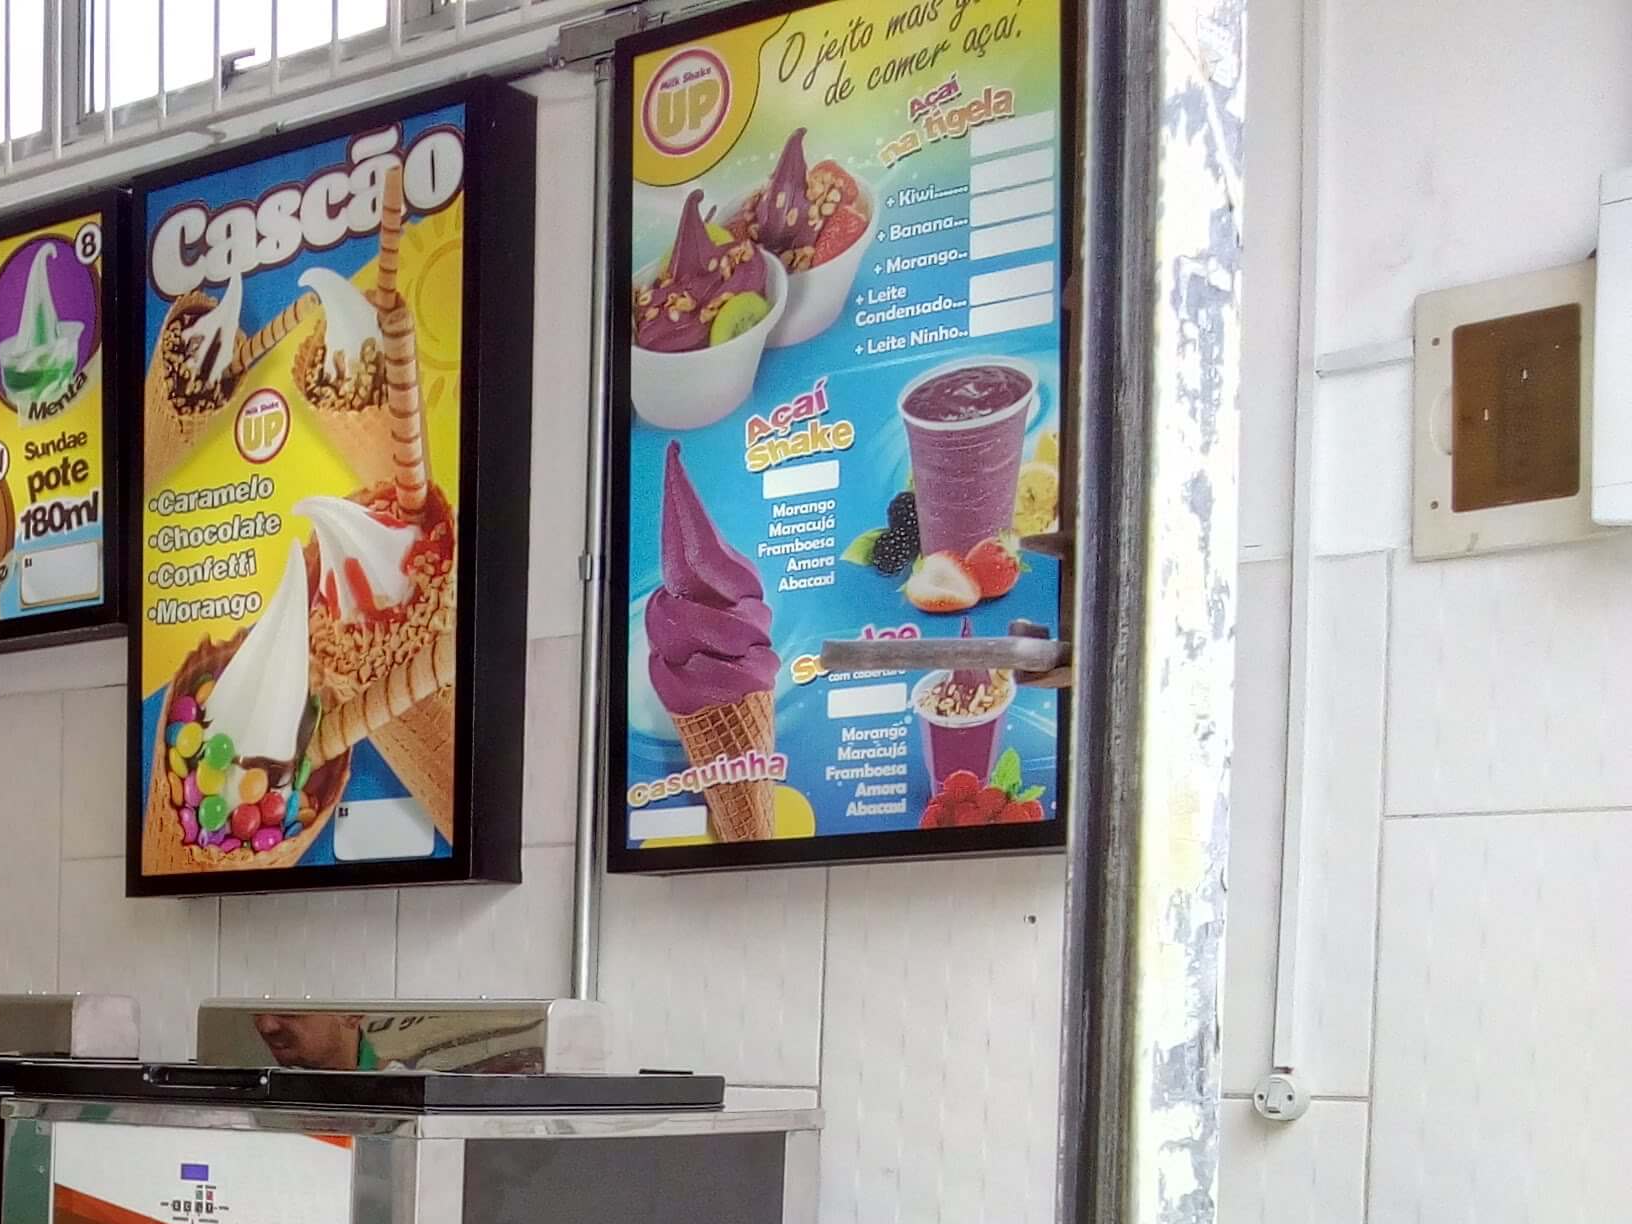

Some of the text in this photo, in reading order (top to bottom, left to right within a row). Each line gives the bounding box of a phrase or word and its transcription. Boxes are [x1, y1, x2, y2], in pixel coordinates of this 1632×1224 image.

[803, 15, 873, 90] jeito
[824, 60, 856, 107] de
[867, 40, 951, 90] comer
[657, 80, 720, 138] UP
[879, 87, 1016, 166] na tigela
[148, 123, 466, 299] Cascão
[82, 231, 96, 257] 8
[868, 286, 906, 304] Leite
[867, 335, 906, 354] Leite
[28, 372, 87, 420] Menta
[746, 376, 829, 449] Açaí
[243, 411, 285, 451] UP
[24, 430, 88, 461] Sundae
[27, 457, 89, 502] pote
[21, 491, 99, 540] 180ml
[773, 500, 836, 518] Morango
[769, 515, 835, 538] Maracujá
[758, 537, 835, 558] Framboesa
[786, 556, 835, 572] Amora
[778, 571, 835, 592] Abacaxi
[842, 727, 908, 743] Morango
[838, 741, 908, 760] Maracujá
[825, 763, 908, 780] Framboesa
